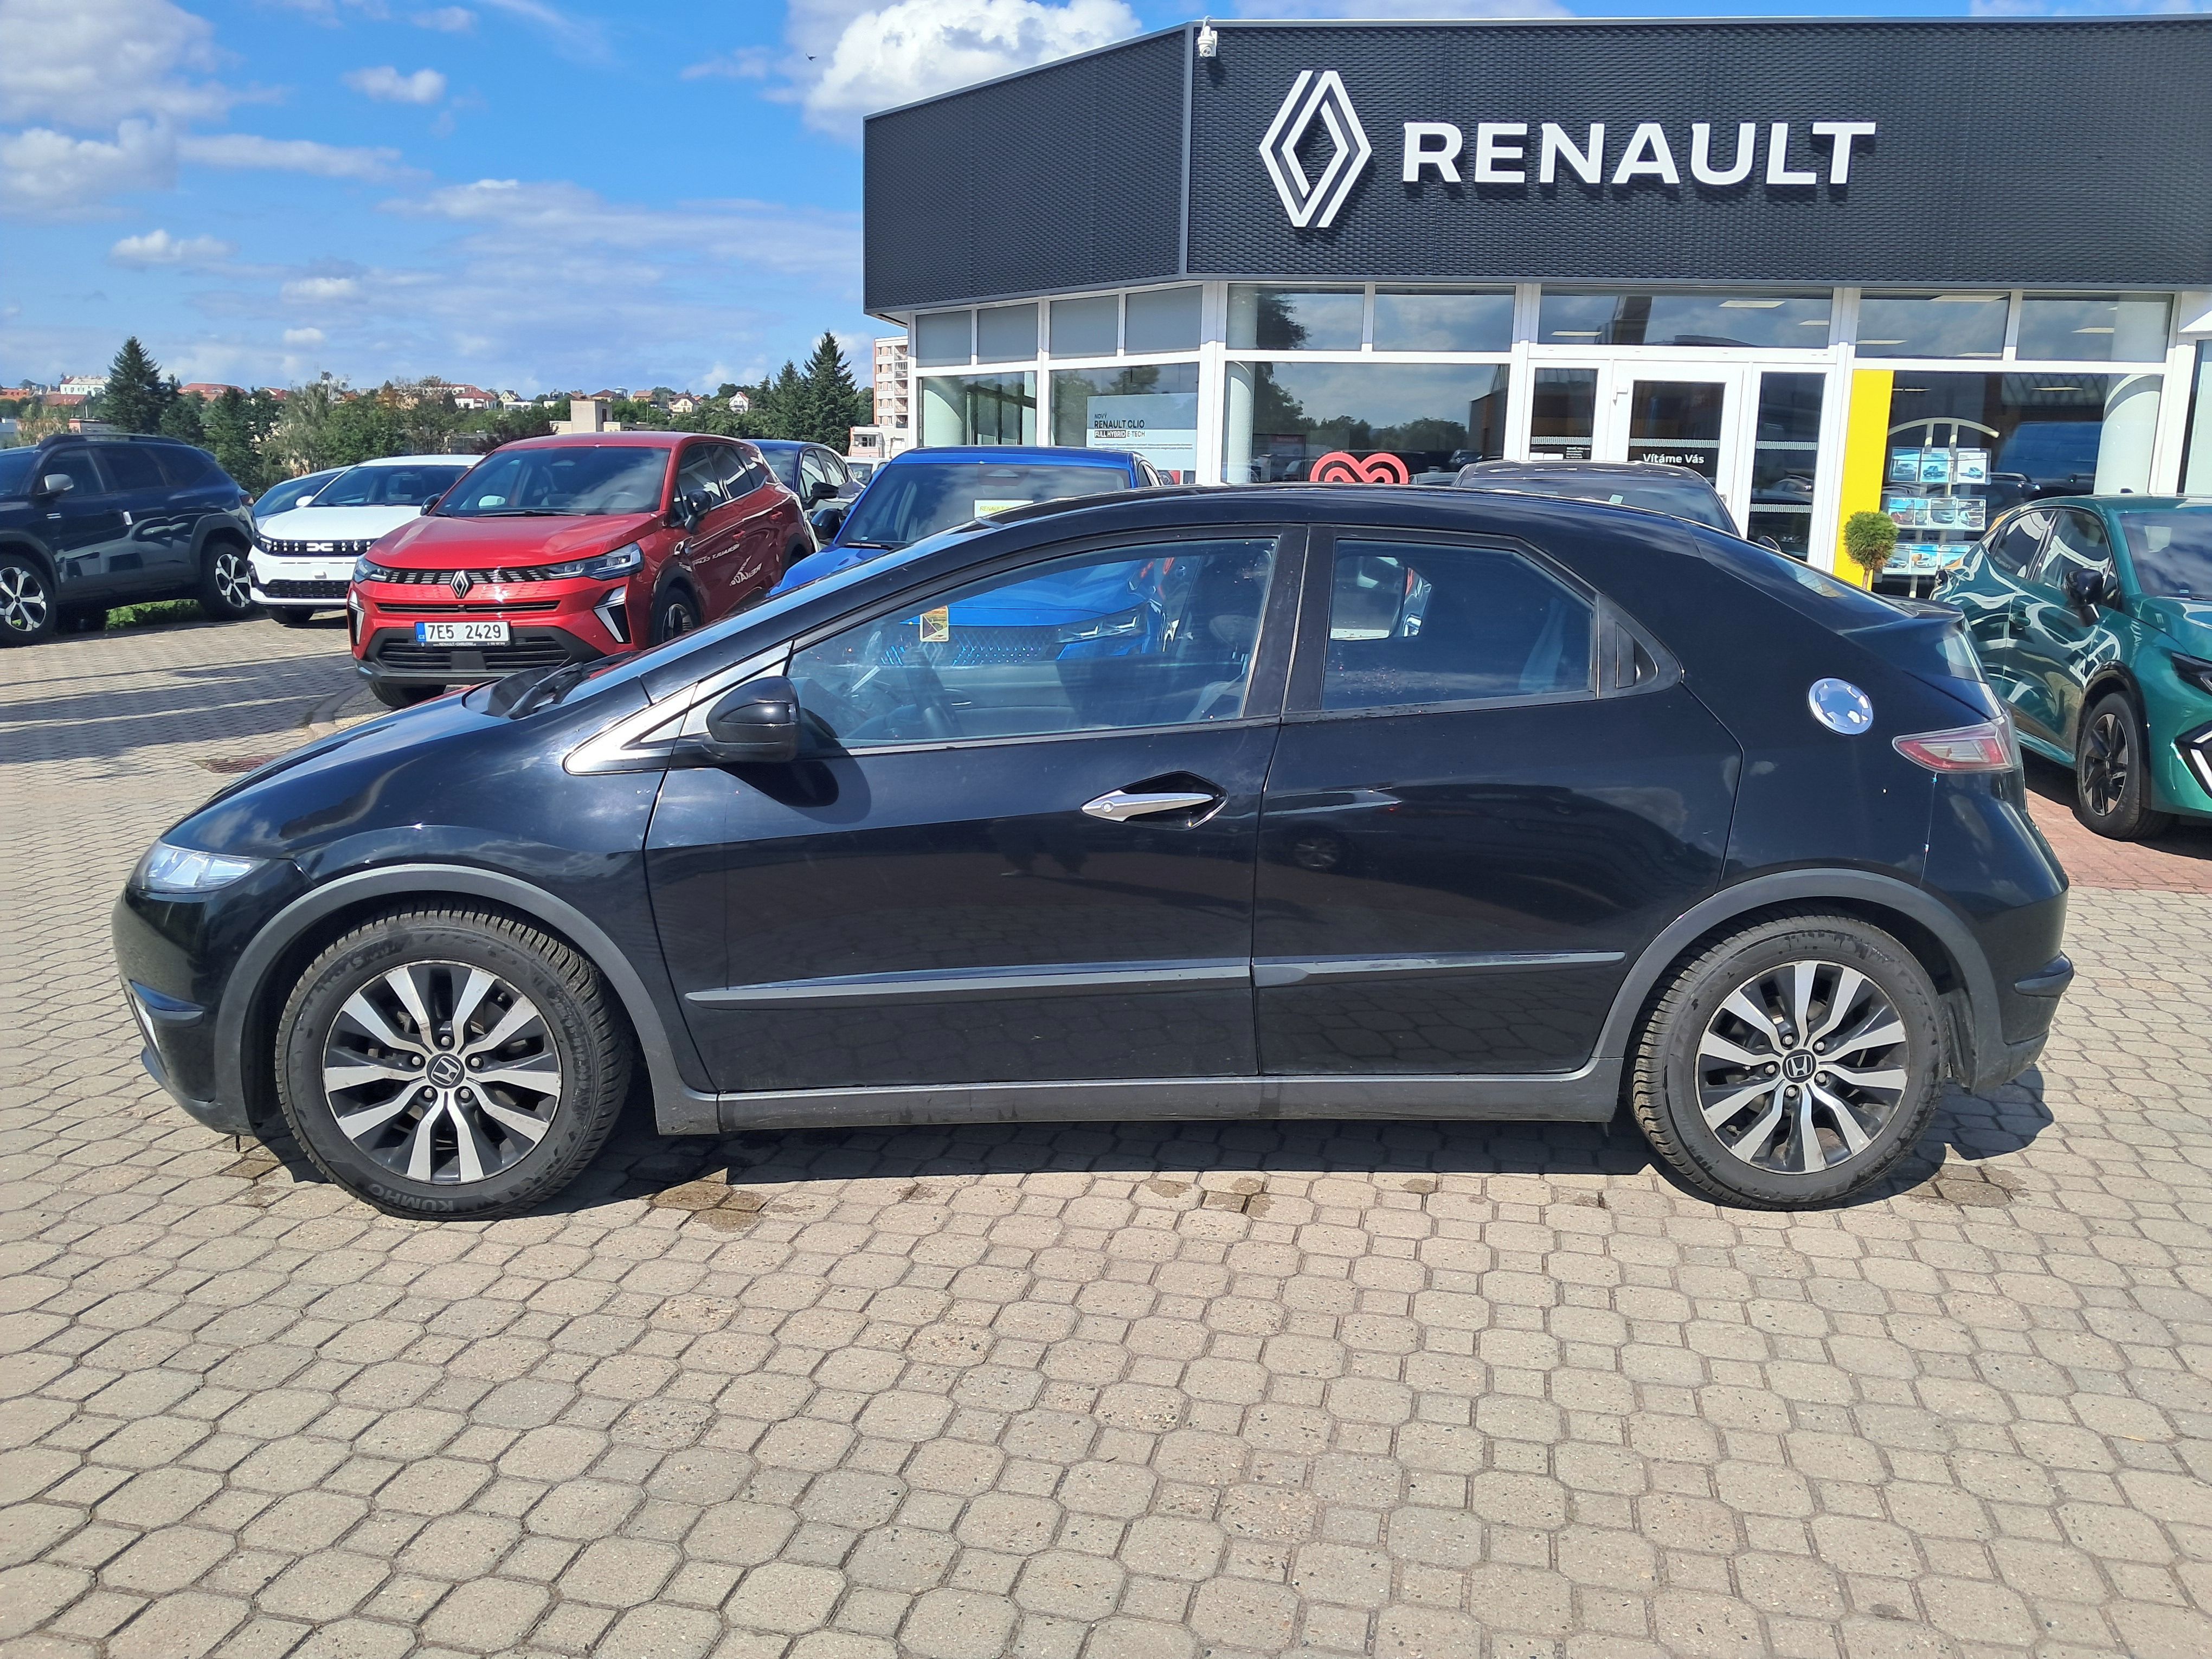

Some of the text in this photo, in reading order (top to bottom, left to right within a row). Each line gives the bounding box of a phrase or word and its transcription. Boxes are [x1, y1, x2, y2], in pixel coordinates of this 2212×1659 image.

[1402, 121, 1876, 184] RENAULT
[1094, 419, 1144, 428] RENAULT CLIO
[1642, 453, 1705, 464] Vítáme Vás
[428, 625, 501, 640] 7E5 2429
[368, 1184, 454, 1211] KUMHO
